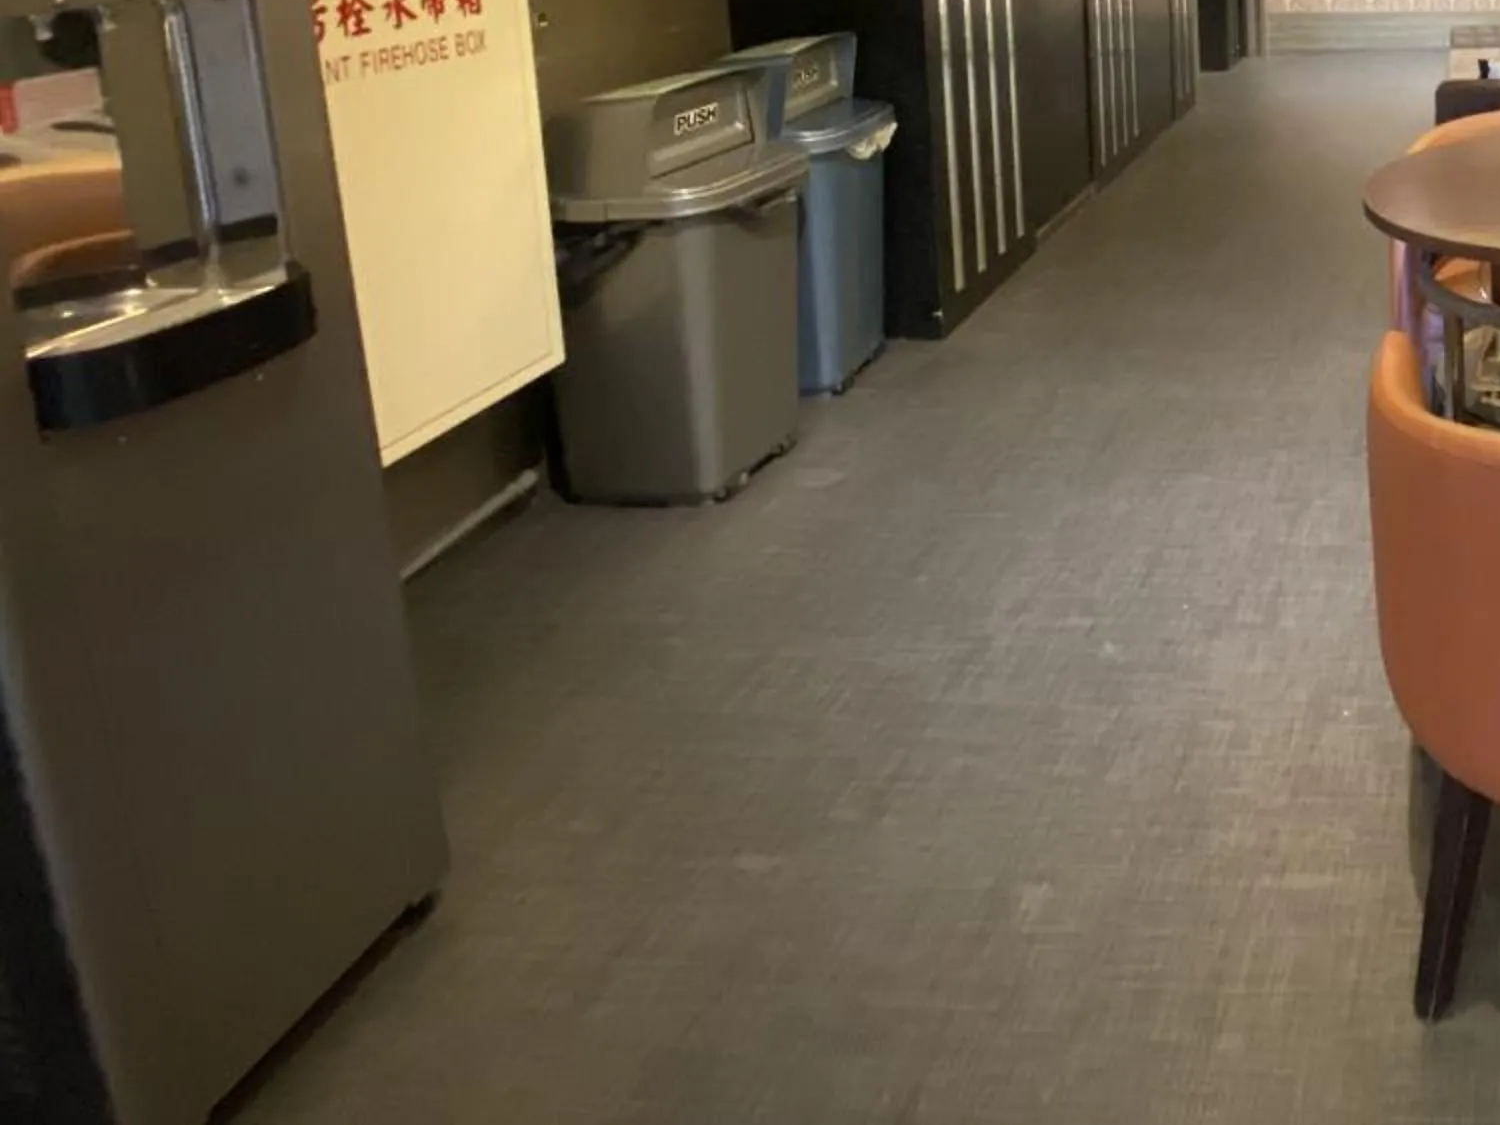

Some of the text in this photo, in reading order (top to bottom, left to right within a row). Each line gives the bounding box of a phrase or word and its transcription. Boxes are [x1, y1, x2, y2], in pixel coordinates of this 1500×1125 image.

[360, 36, 449, 78] FIREHOSE
[455, 29, 487, 57] BOX
[676, 103, 718, 133] PUSH
